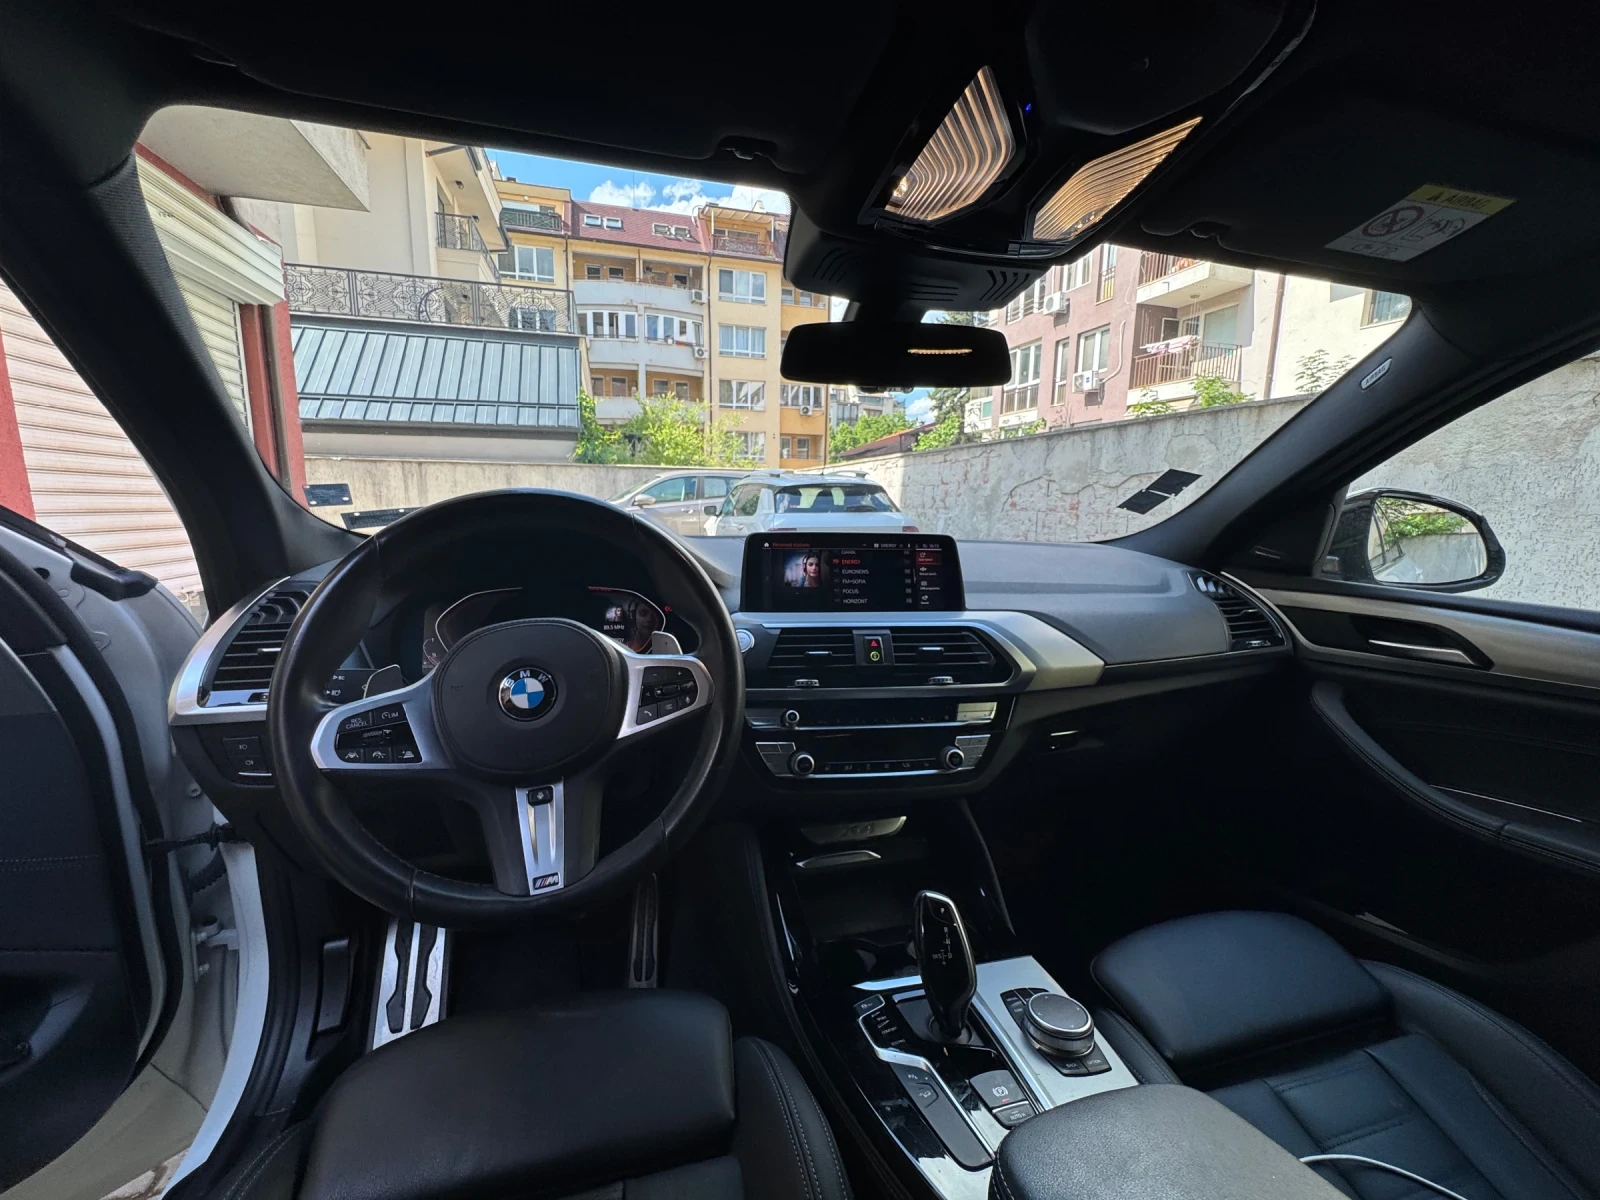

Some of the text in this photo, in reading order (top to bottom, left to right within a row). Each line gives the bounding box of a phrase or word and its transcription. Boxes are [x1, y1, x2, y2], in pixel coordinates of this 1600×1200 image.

[1444, 193, 1492, 209] AIRBAG
[1365, 366, 1386, 385] AIRBAG
[504, 667, 549, 688] BMW
[345, 720, 368, 730] CANCEL
[881, 1026, 897, 1035] COMFORT
